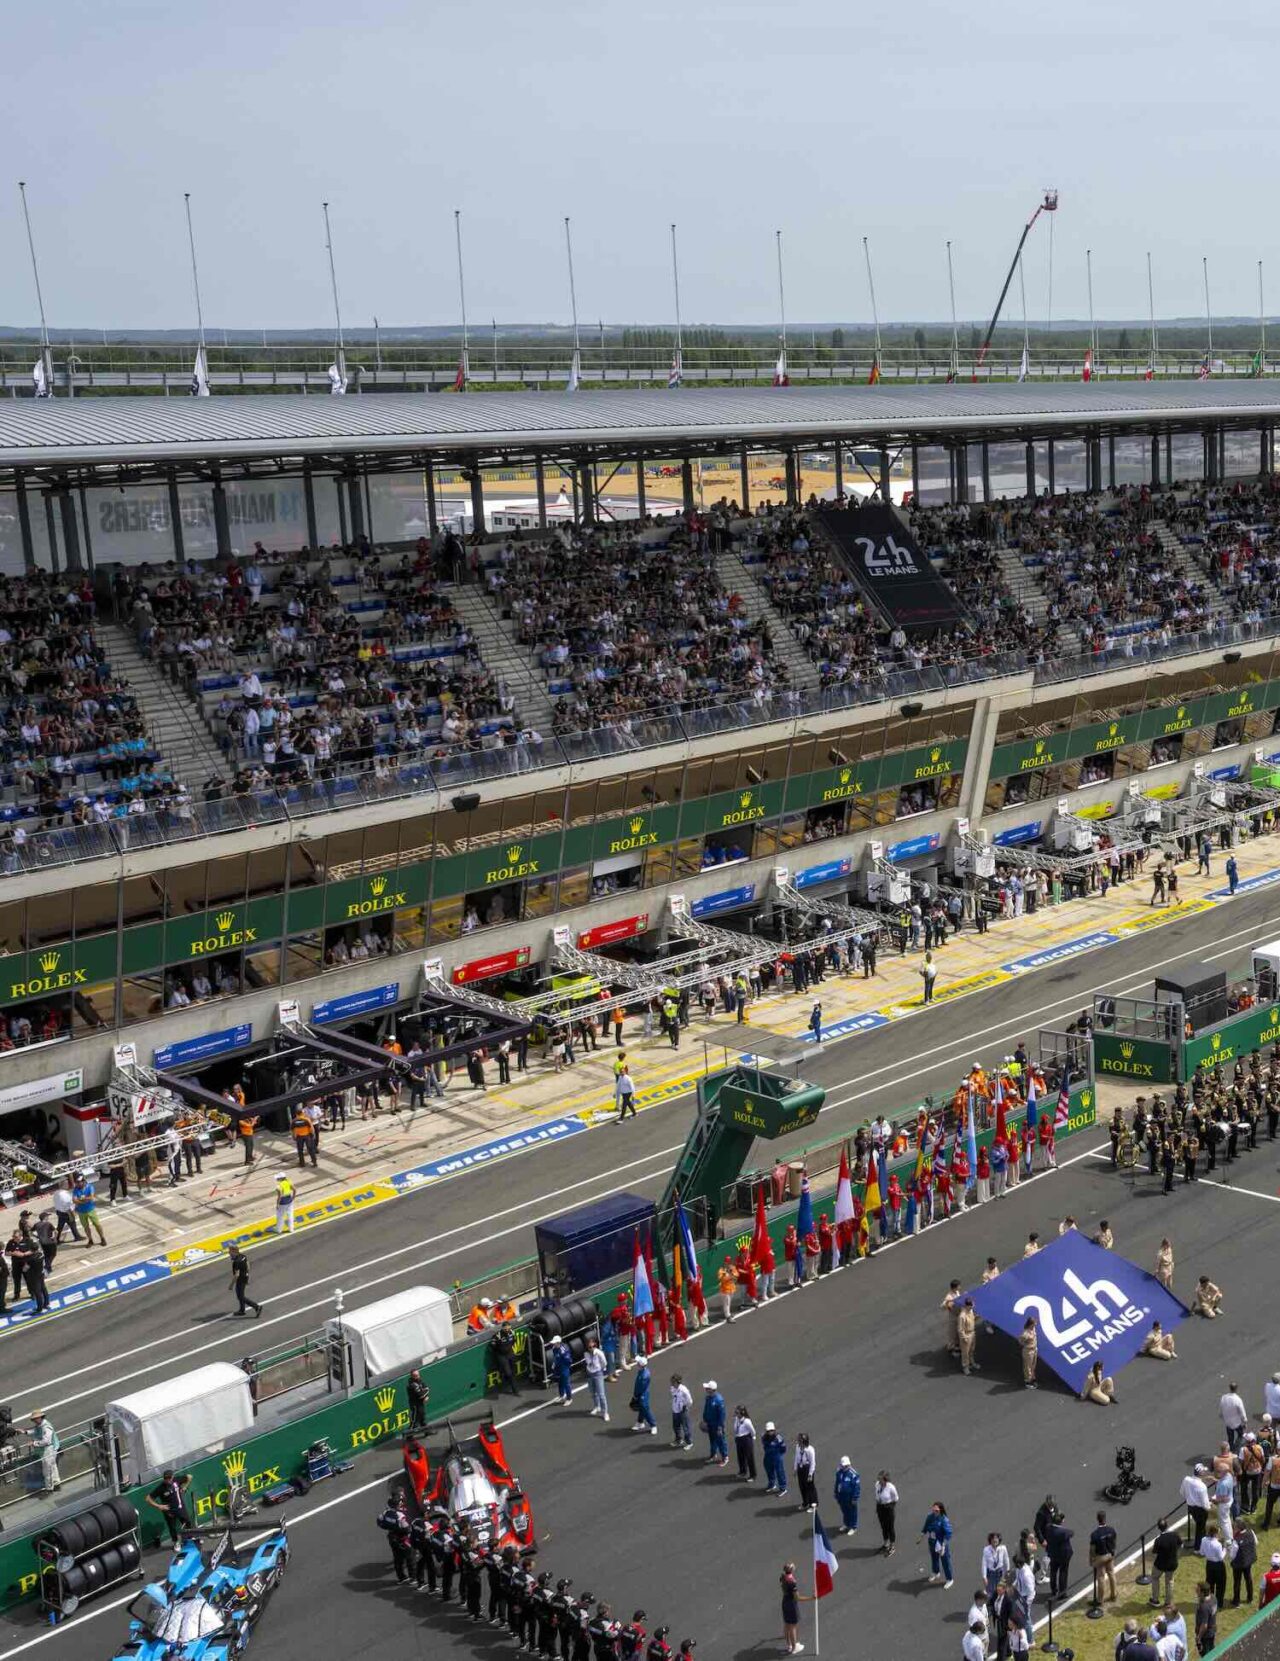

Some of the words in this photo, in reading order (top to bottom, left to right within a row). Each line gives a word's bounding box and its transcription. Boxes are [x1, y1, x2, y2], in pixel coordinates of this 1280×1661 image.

[855, 536, 914, 568] 24h
[868, 567, 884, 577] LE
[885, 565, 919, 576] MANS
[1228, 702, 1254, 717] ROLEX
[1165, 719, 1192, 733] ROLEX
[1096, 735, 1126, 750] ROLEX
[915, 761, 952, 778] ROLEX
[1021, 753, 1054, 769] ROLEX
[824, 782, 862, 800] ROLEX
[723, 806, 765, 825] ROLEX
[610, 832, 659, 853] ROLEX
[486, 860, 539, 884] ROLEX
[347, 892, 406, 917] ROLEX
[190, 928, 257, 955] ROLEX
[1030, 936, 1108, 966] MICHELIN
[11, 969, 88, 999] ROLEX
[1102, 1058, 1153, 1076] ROLEX
[1201, 1047, 1234, 1069] ROLEX
[734, 1111, 766, 1129] ROLEX
[779, 1112, 818, 1134] ROLEX
[437, 1124, 569, 1174] MICHELIN
[1013, 1269, 1130, 1348] 24h
[1061, 1341, 1090, 1365] LE
[1087, 1305, 1146, 1350] MANS
[351, 1408, 411, 1448] ROLE
